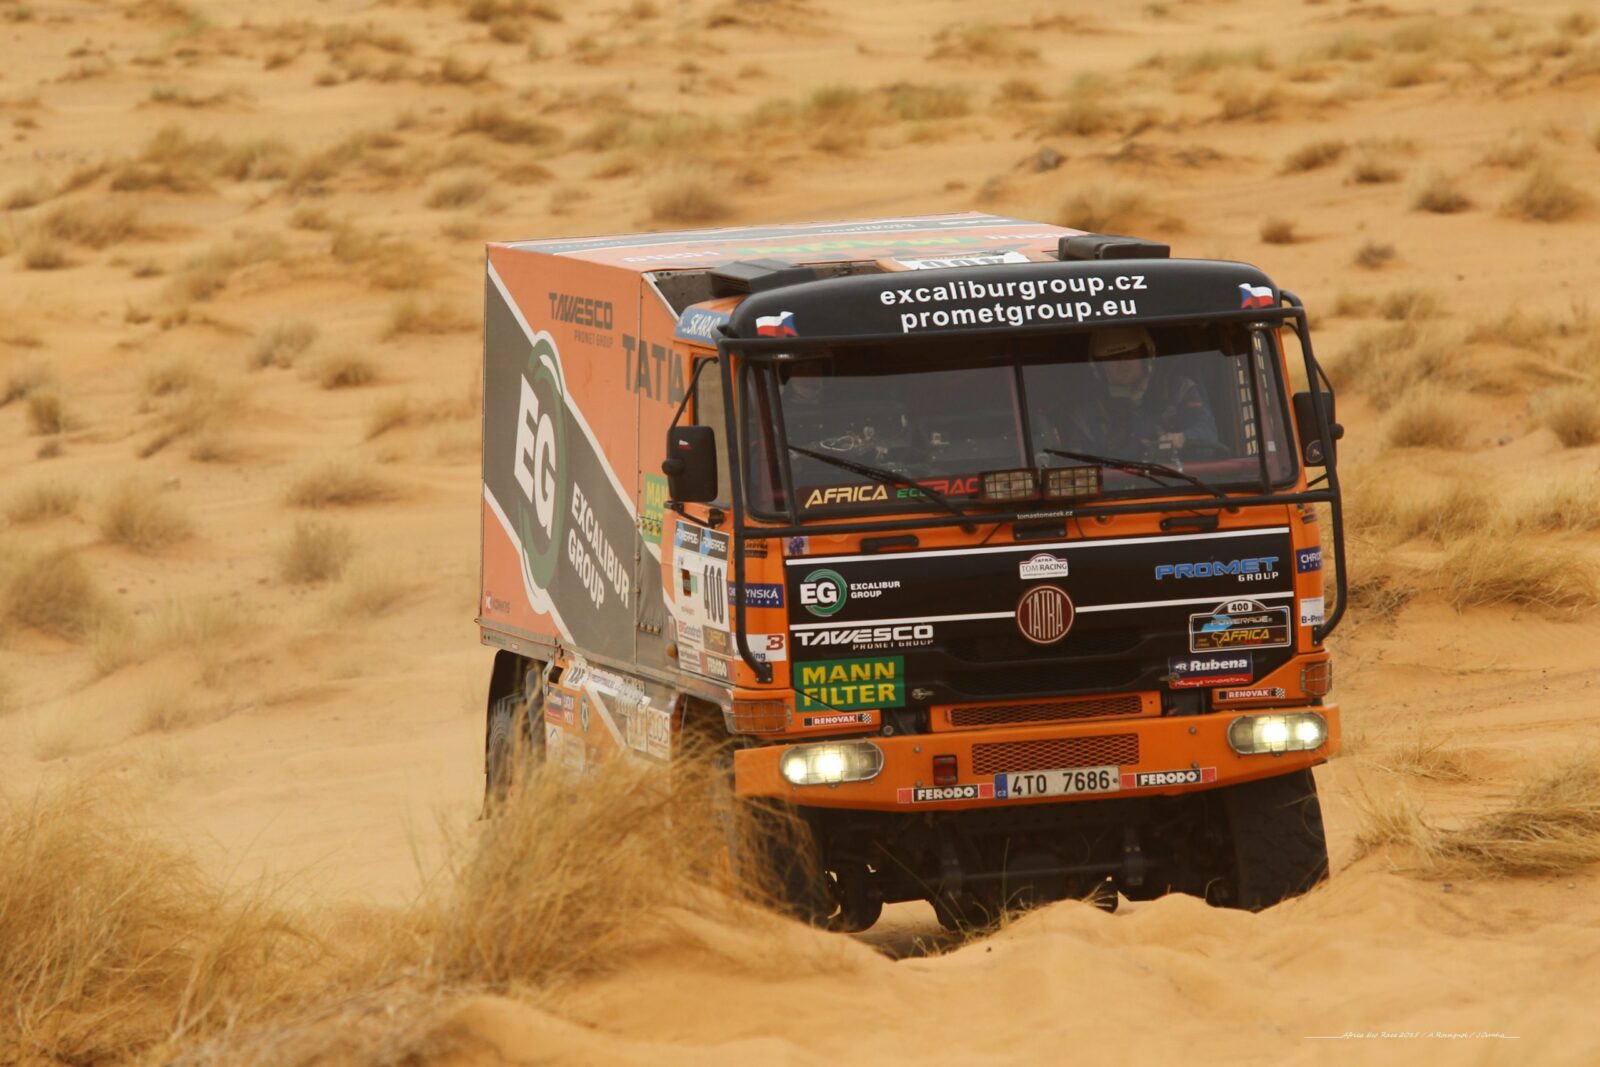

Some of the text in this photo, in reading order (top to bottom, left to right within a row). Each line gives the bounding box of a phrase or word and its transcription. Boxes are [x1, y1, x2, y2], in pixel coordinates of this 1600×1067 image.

[880, 274, 1147, 305] excaliburgroup.cz
[548, 292, 613, 331] TAWESCO
[901, 299, 1137, 333] prometgroup.eu
[514, 373, 556, 540] EG
[805, 485, 888, 509] AFRICA
[1017, 510, 1073, 520] tomastomecek.cz
[571, 481, 629, 608] EXCALIBUR
[568, 528, 604, 609] GROUP
[1021, 562, 1067, 573] TOM RACING
[1155, 556, 1279, 581] PROMET
[1238, 571, 1279, 582] GROUP
[703, 563, 725, 625] 400
[800, 581, 838, 605] EG
[850, 580, 901, 591] EXCALIBUR
[850, 590, 882, 599] GROUP
[1026, 590, 1063, 639] TATRA
[1231, 602, 1249, 611] 400
[794, 624, 934, 646] TAWESCO
[852, 638, 934, 650] PROMET GROUP
[1219, 628, 1270, 642] AFRICA
[803, 661, 895, 685] MANN
[1190, 659, 1248, 671] Rubena
[804, 683, 897, 707] FILTER
[1228, 689, 1269, 698] RENOVAK
[814, 715, 856, 725] RENOVAK
[1062, 770, 1110, 792] 7686
[1140, 770, 1198, 785] FERODO
[918, 786, 975, 800] FERODO
